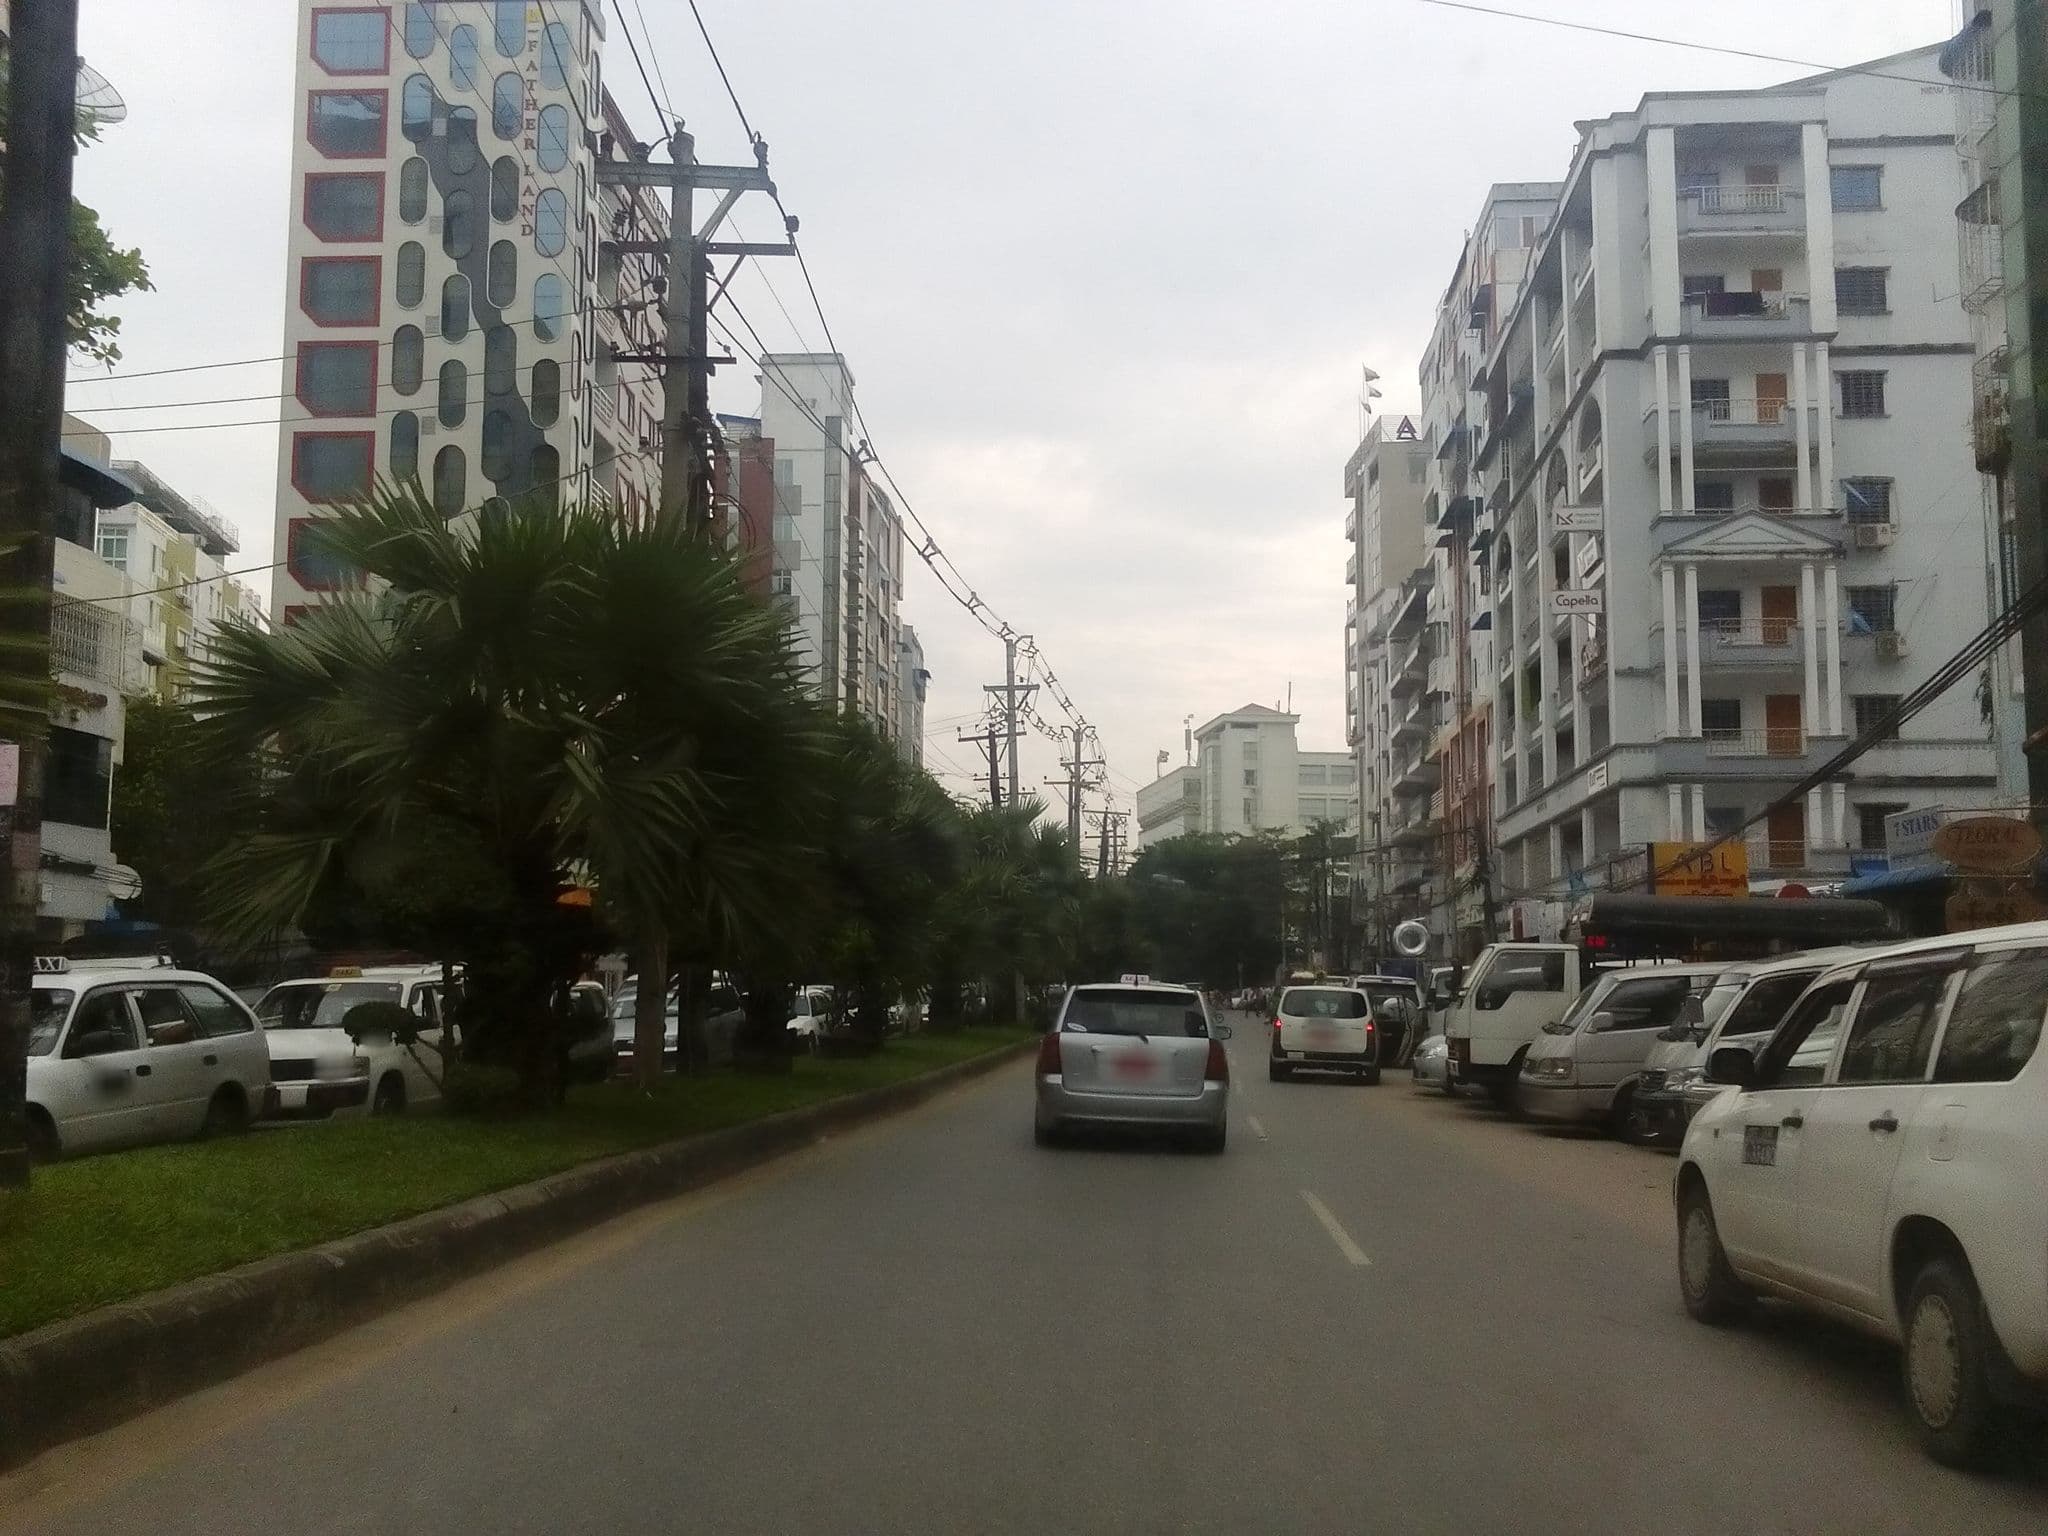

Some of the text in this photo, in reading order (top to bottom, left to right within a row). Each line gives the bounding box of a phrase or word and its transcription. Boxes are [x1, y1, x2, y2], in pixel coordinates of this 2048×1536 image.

[521, 41, 538, 236] FATHER LAND
[1555, 594, 1599, 608] Capella
[1901, 813, 1939, 836] STARS
